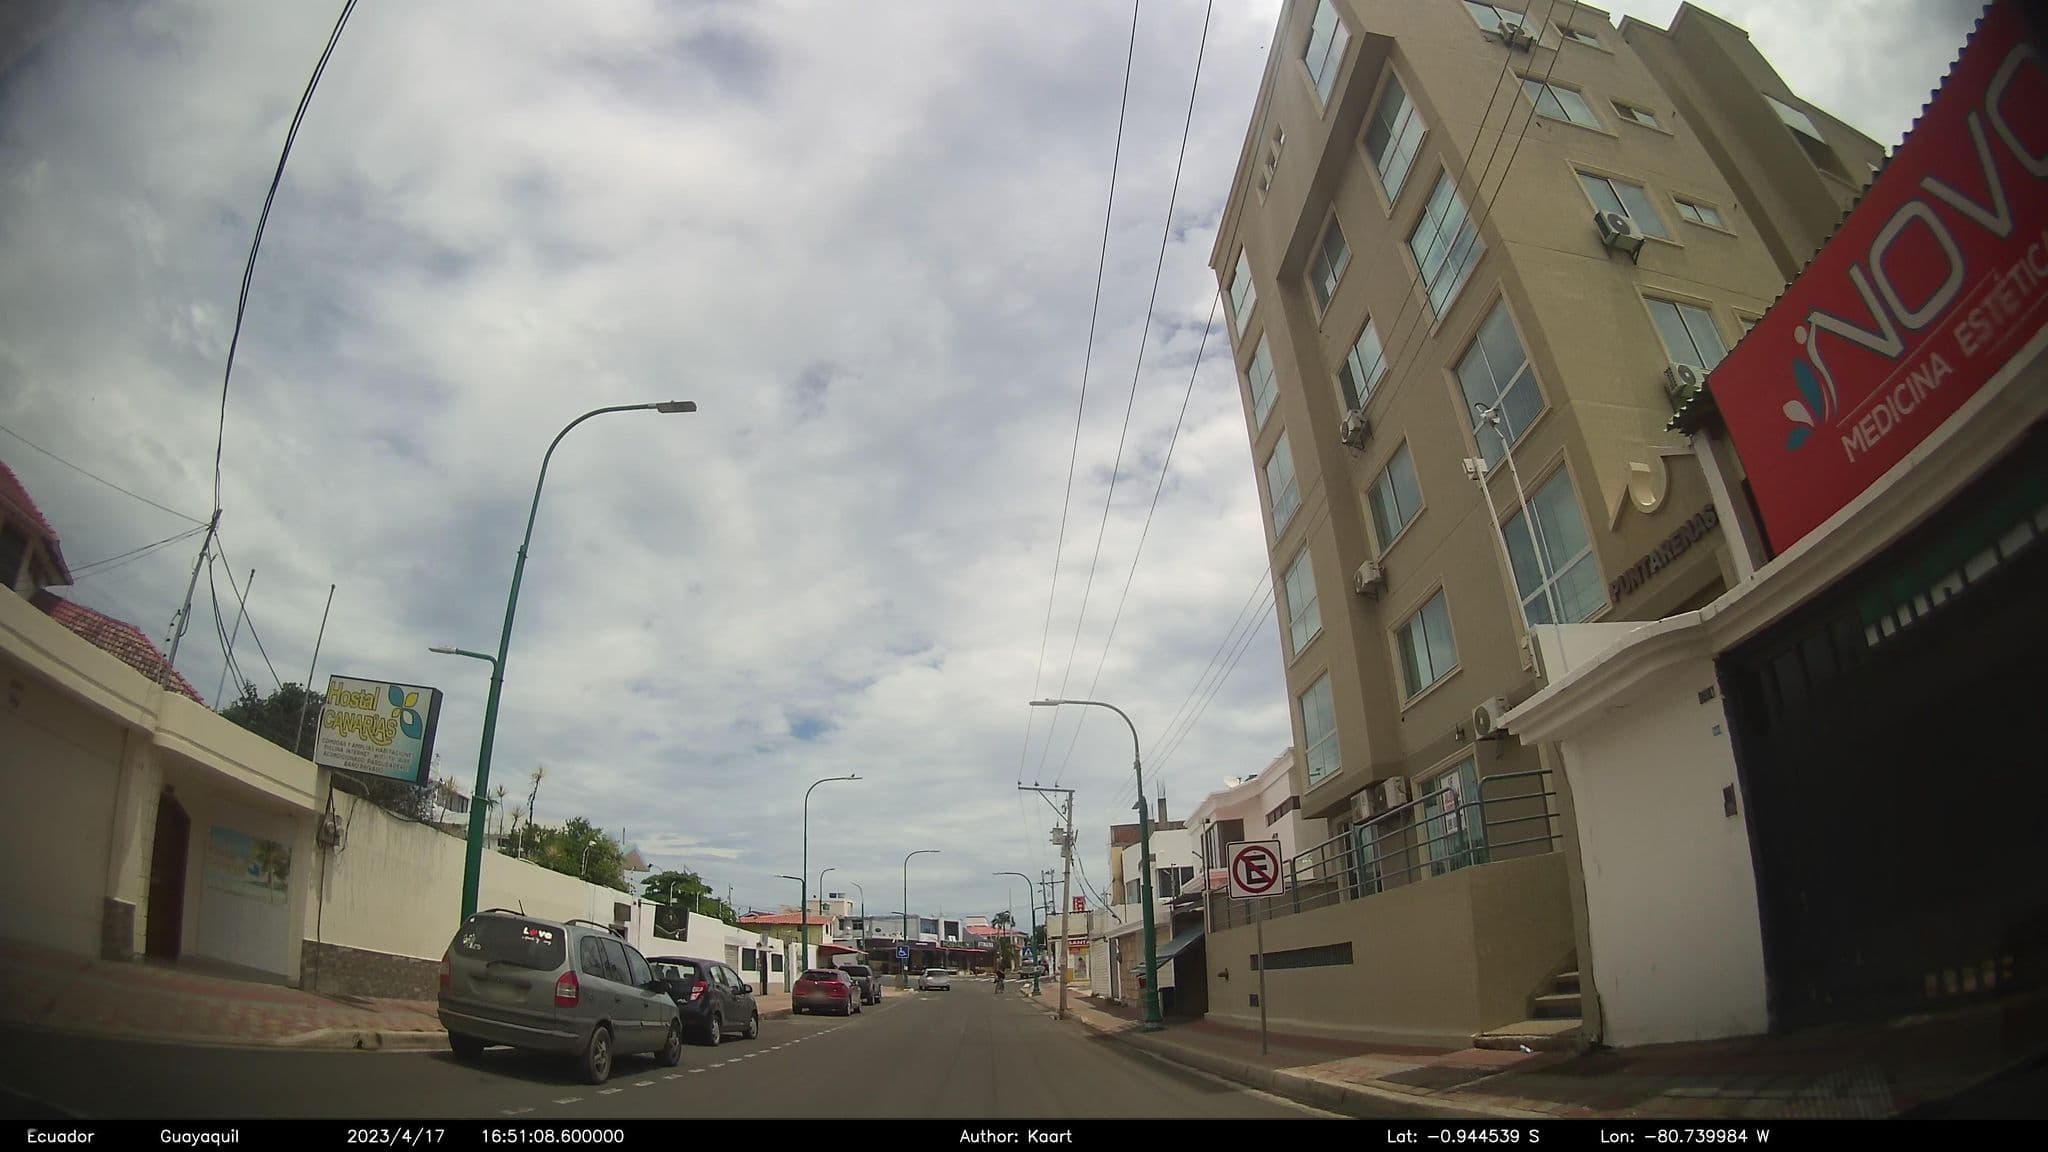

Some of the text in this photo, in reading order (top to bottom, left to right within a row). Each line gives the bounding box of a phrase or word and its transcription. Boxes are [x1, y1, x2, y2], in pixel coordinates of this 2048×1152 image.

[1840, 352, 1953, 463] MEDICINA
[1608, 503, 1719, 603] PUNTARENAS
[328, 681, 380, 711] Hostal
[322, 709, 398, 747] CANARIAS
[1246, 854, 1268, 885] E
